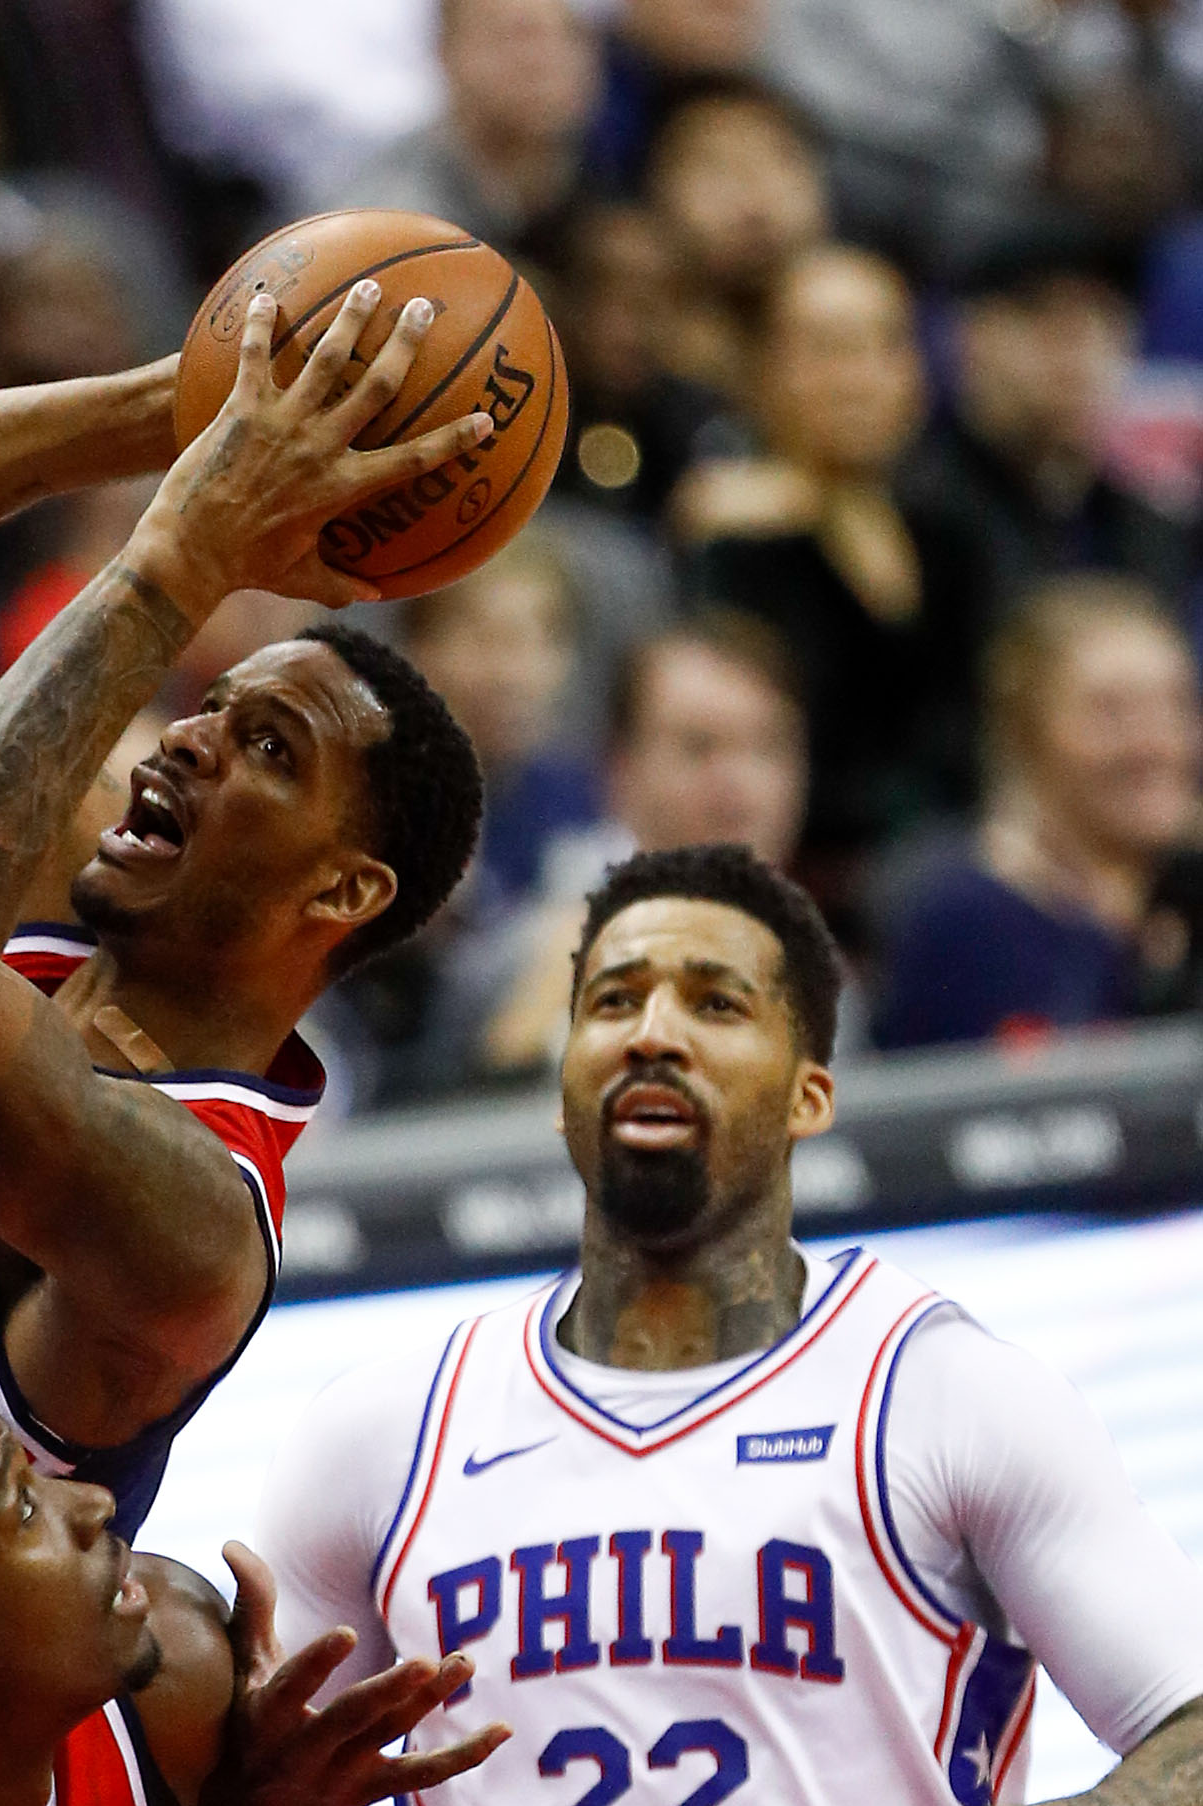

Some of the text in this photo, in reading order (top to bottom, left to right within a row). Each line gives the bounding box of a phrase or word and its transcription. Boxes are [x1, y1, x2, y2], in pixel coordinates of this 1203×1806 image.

[319, 344, 535, 564] SPDING
[747, 1436, 823, 1459] StubHub
[427, 1530, 845, 1710] PHILA
